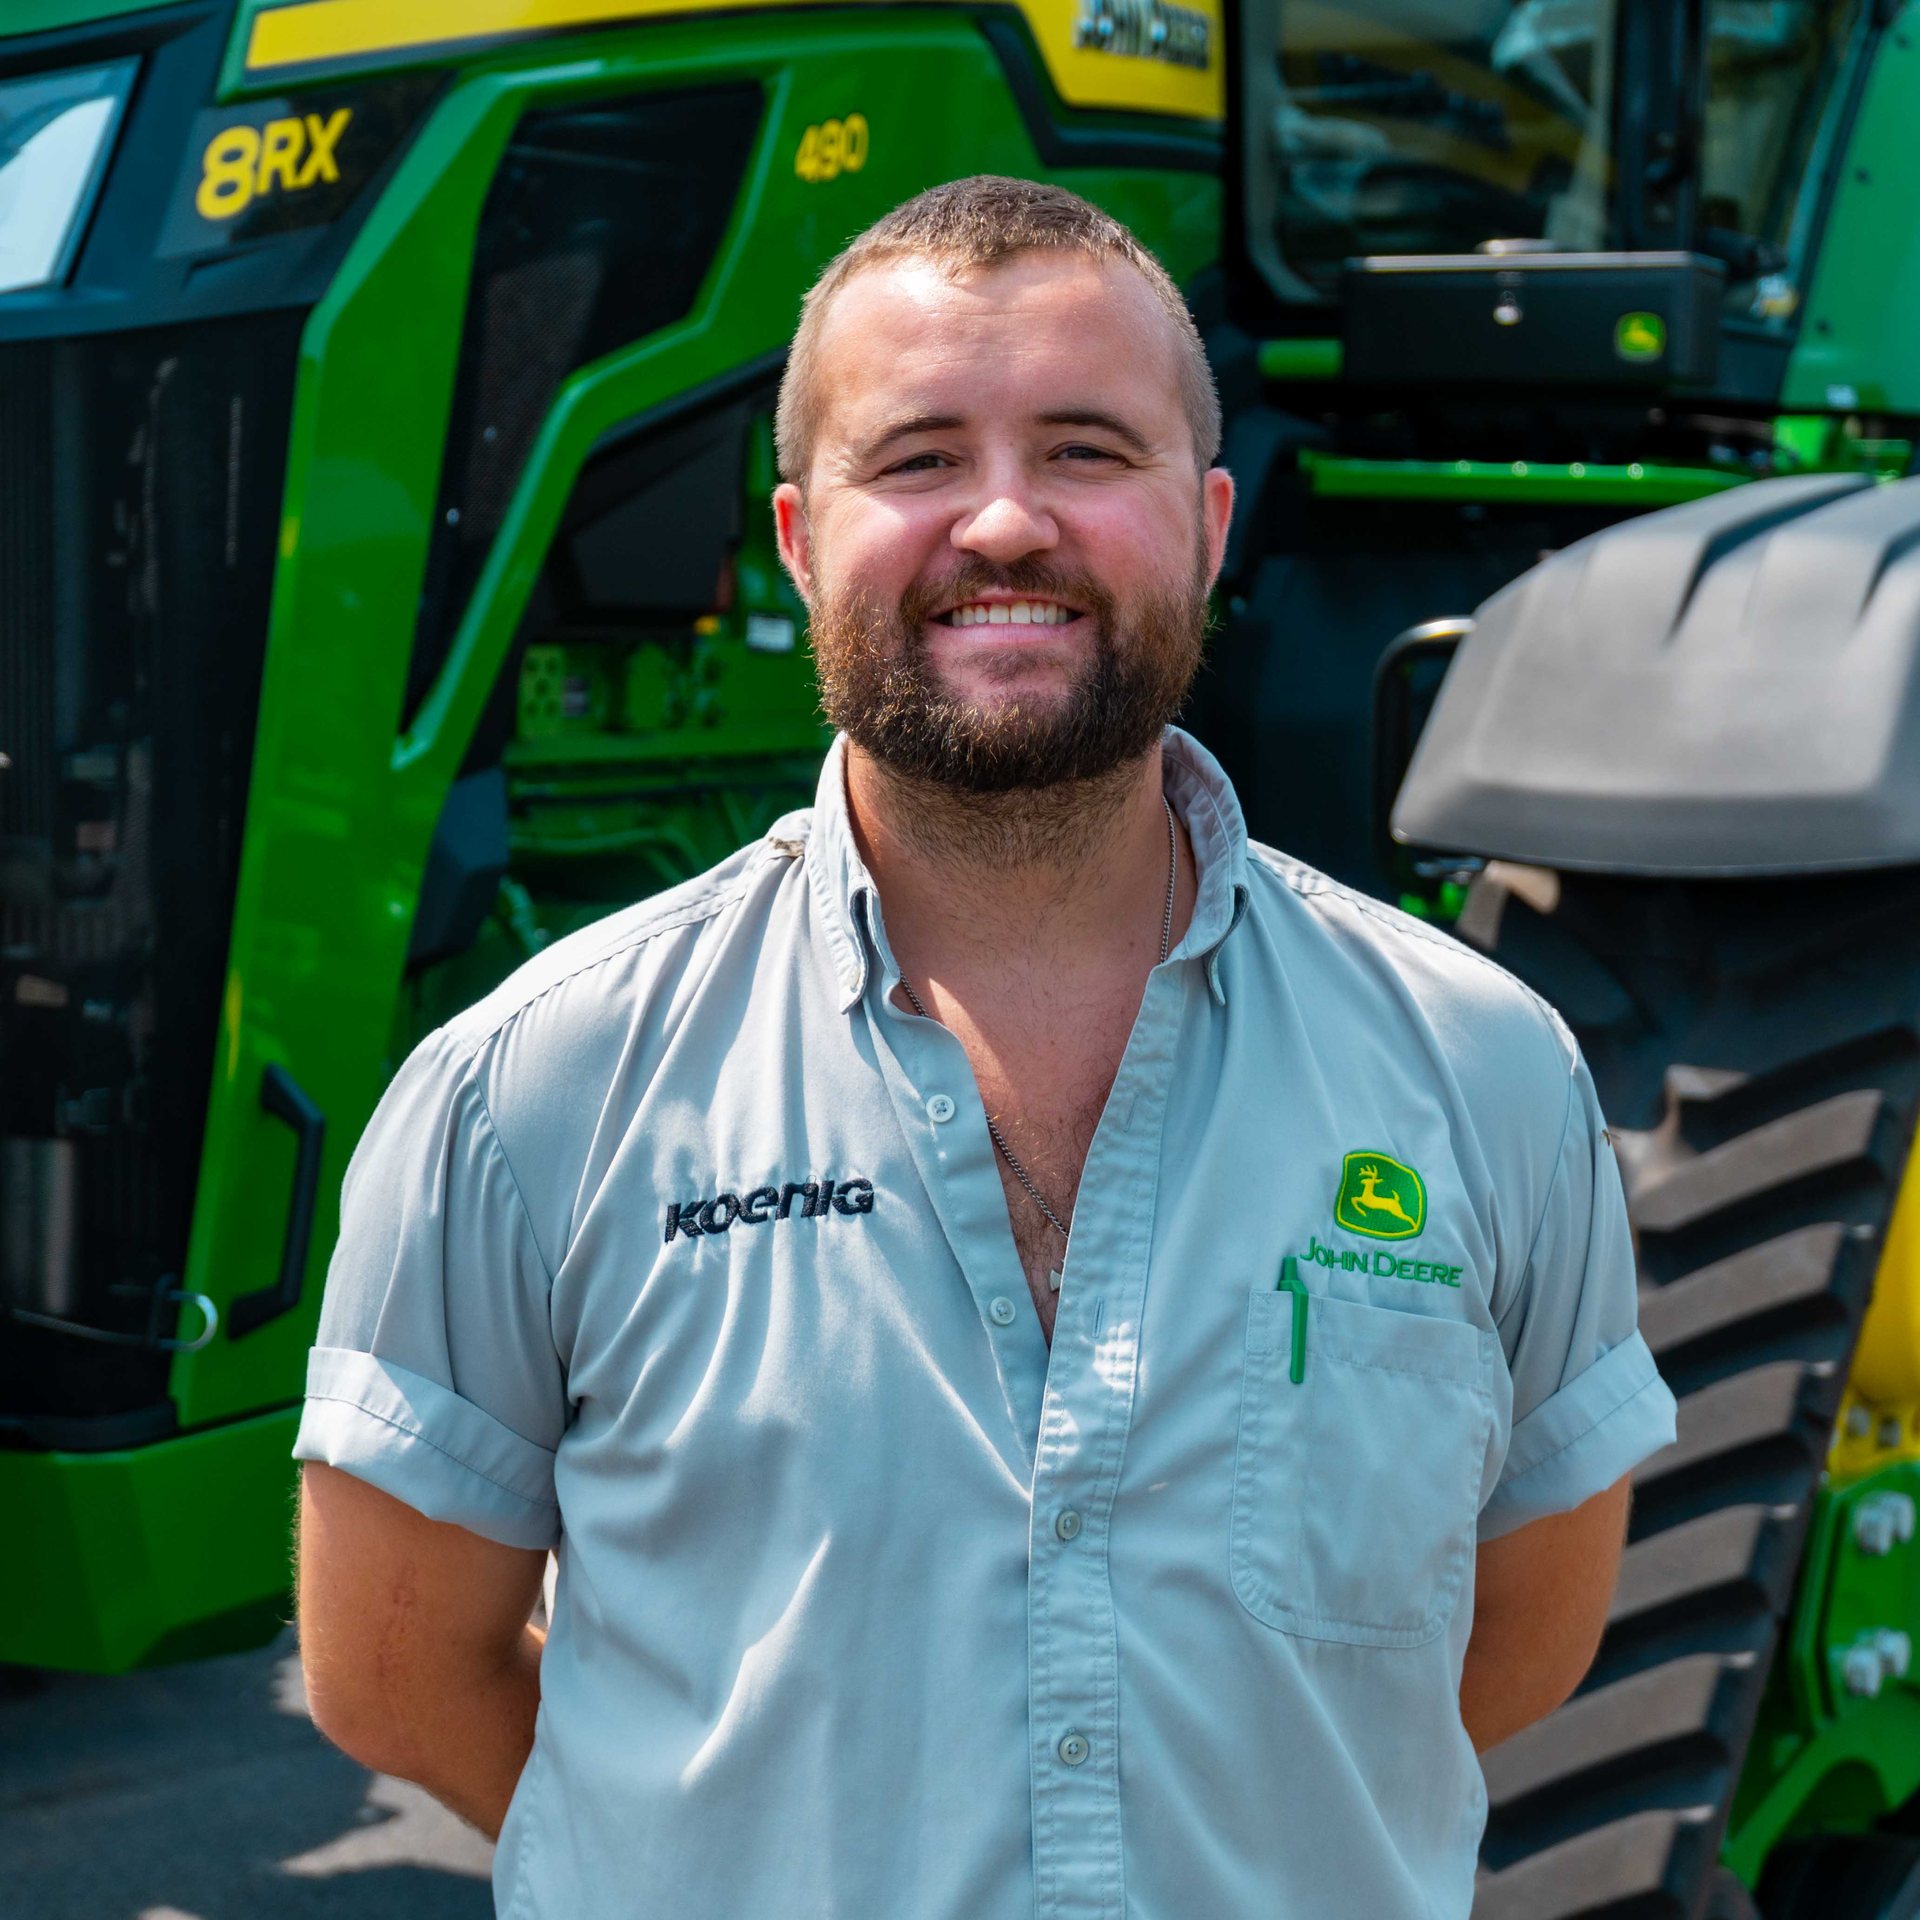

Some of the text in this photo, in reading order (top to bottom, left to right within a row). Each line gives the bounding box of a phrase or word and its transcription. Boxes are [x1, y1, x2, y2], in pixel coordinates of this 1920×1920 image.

[196, 107, 352, 220] 8RX
[1300, 1236, 1463, 1288] JOHN DEERE
